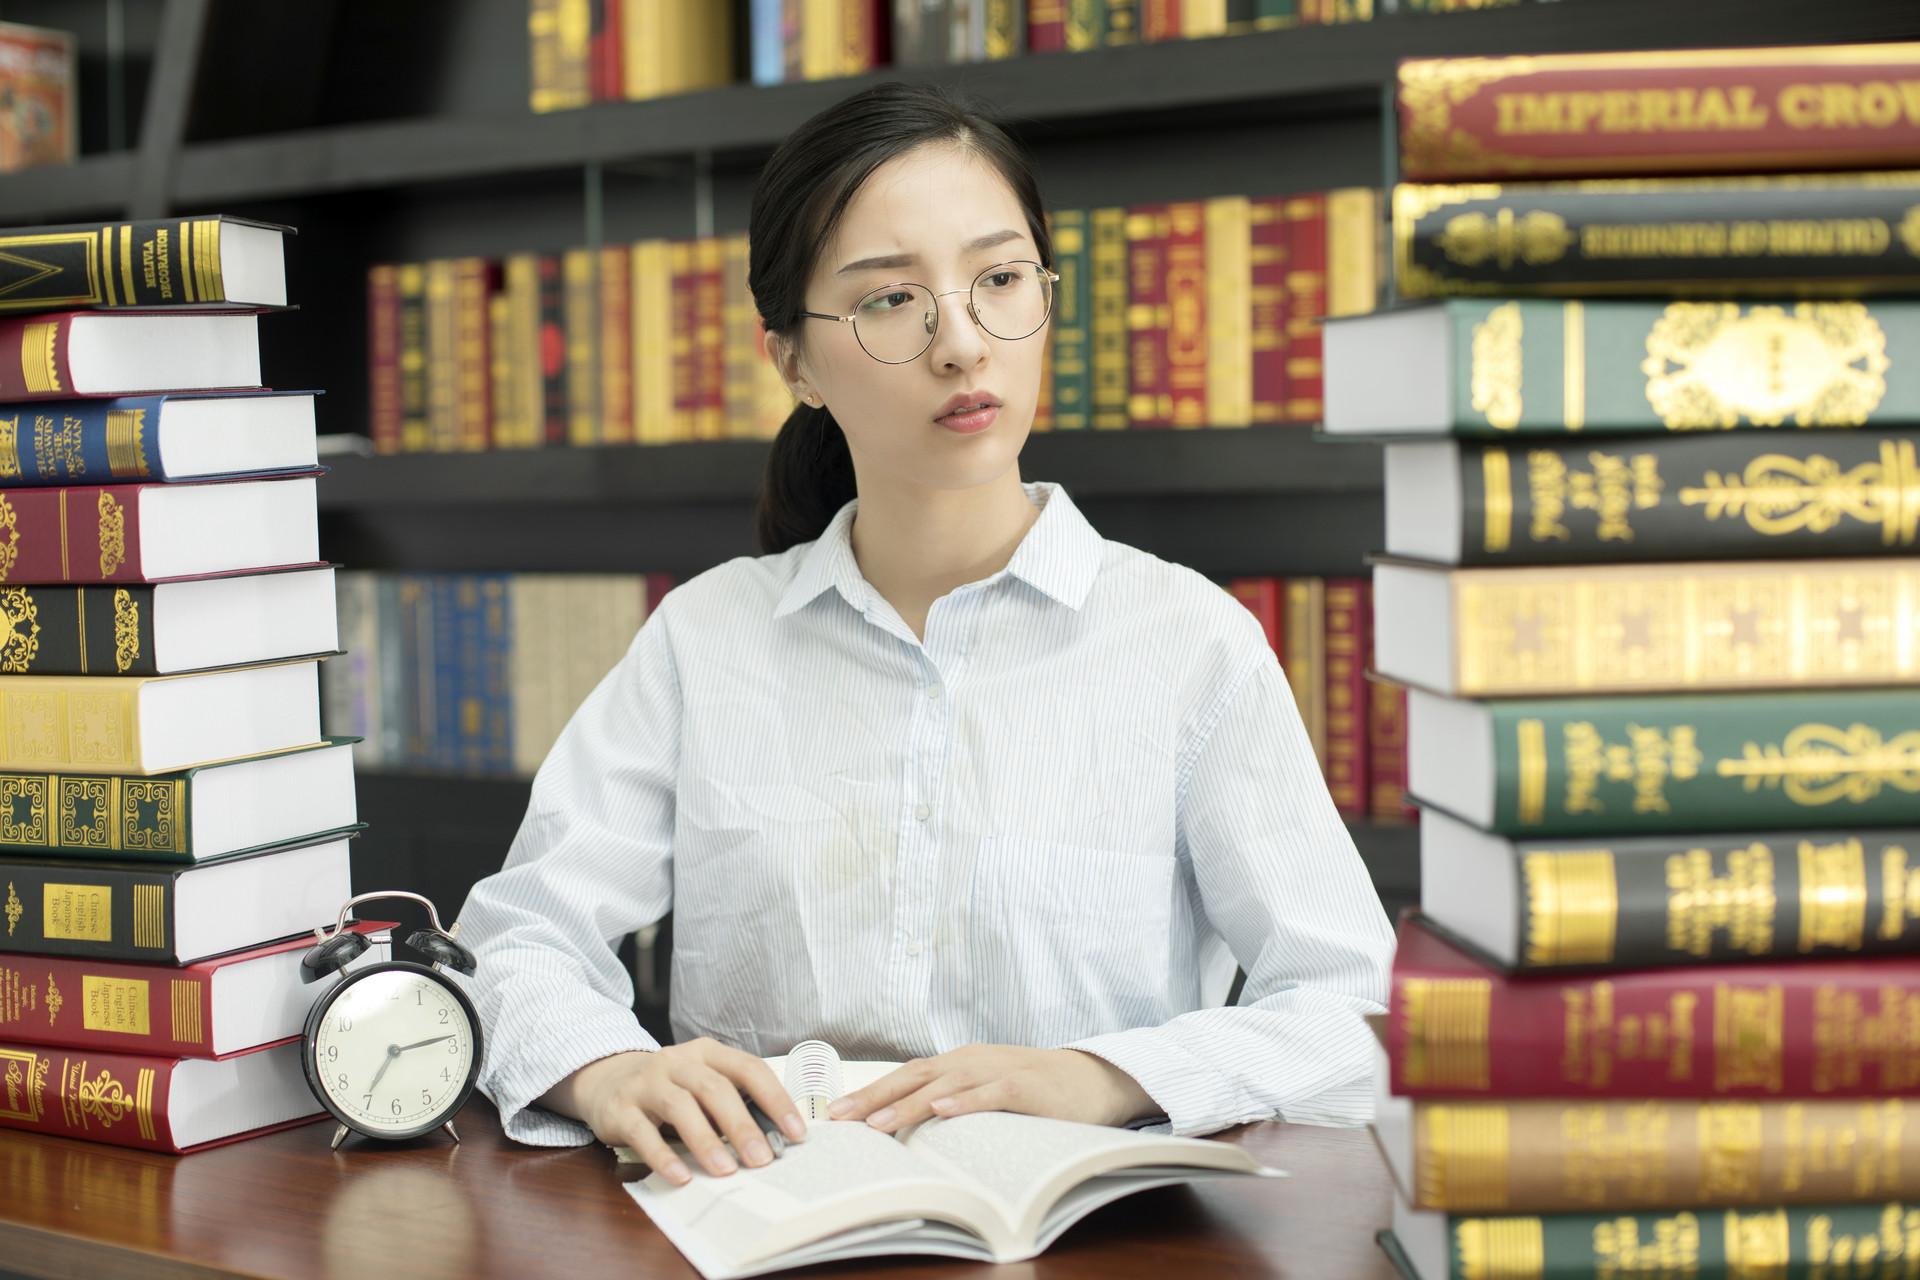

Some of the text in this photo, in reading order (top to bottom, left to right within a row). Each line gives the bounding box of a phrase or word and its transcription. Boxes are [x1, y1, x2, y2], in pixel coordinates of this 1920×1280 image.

[1496, 86, 1769, 135] IMPERIAL
[156, 229, 173, 298] DECORATION
[54, 432, 65, 460] THE
[73, 419, 82, 452] MAN
[52, 896, 60, 926] Book
[63, 889, 73, 934] Japanese
[75, 894, 87, 931] English
[90, 893, 99, 934] Chinese
[90, 990, 99, 1017] Book
[101, 982, 111, 1026] Japanese
[114, 986, 125, 1024] English
[128, 986, 137, 1027] Chinese
[416, 990, 423, 1006] 1
[337, 1015, 353, 1033] 10
[438, 1008, 449, 1025] 2
[327, 1045, 338, 1062] 9
[447, 1038, 458, 1055] 3
[338, 1073, 349, 1091] 8
[440, 1067, 451, 1082] 4
[362, 1094, 373, 1111] 7
[391, 1098, 402, 1116] 6
[422, 1089, 432, 1106] 5
